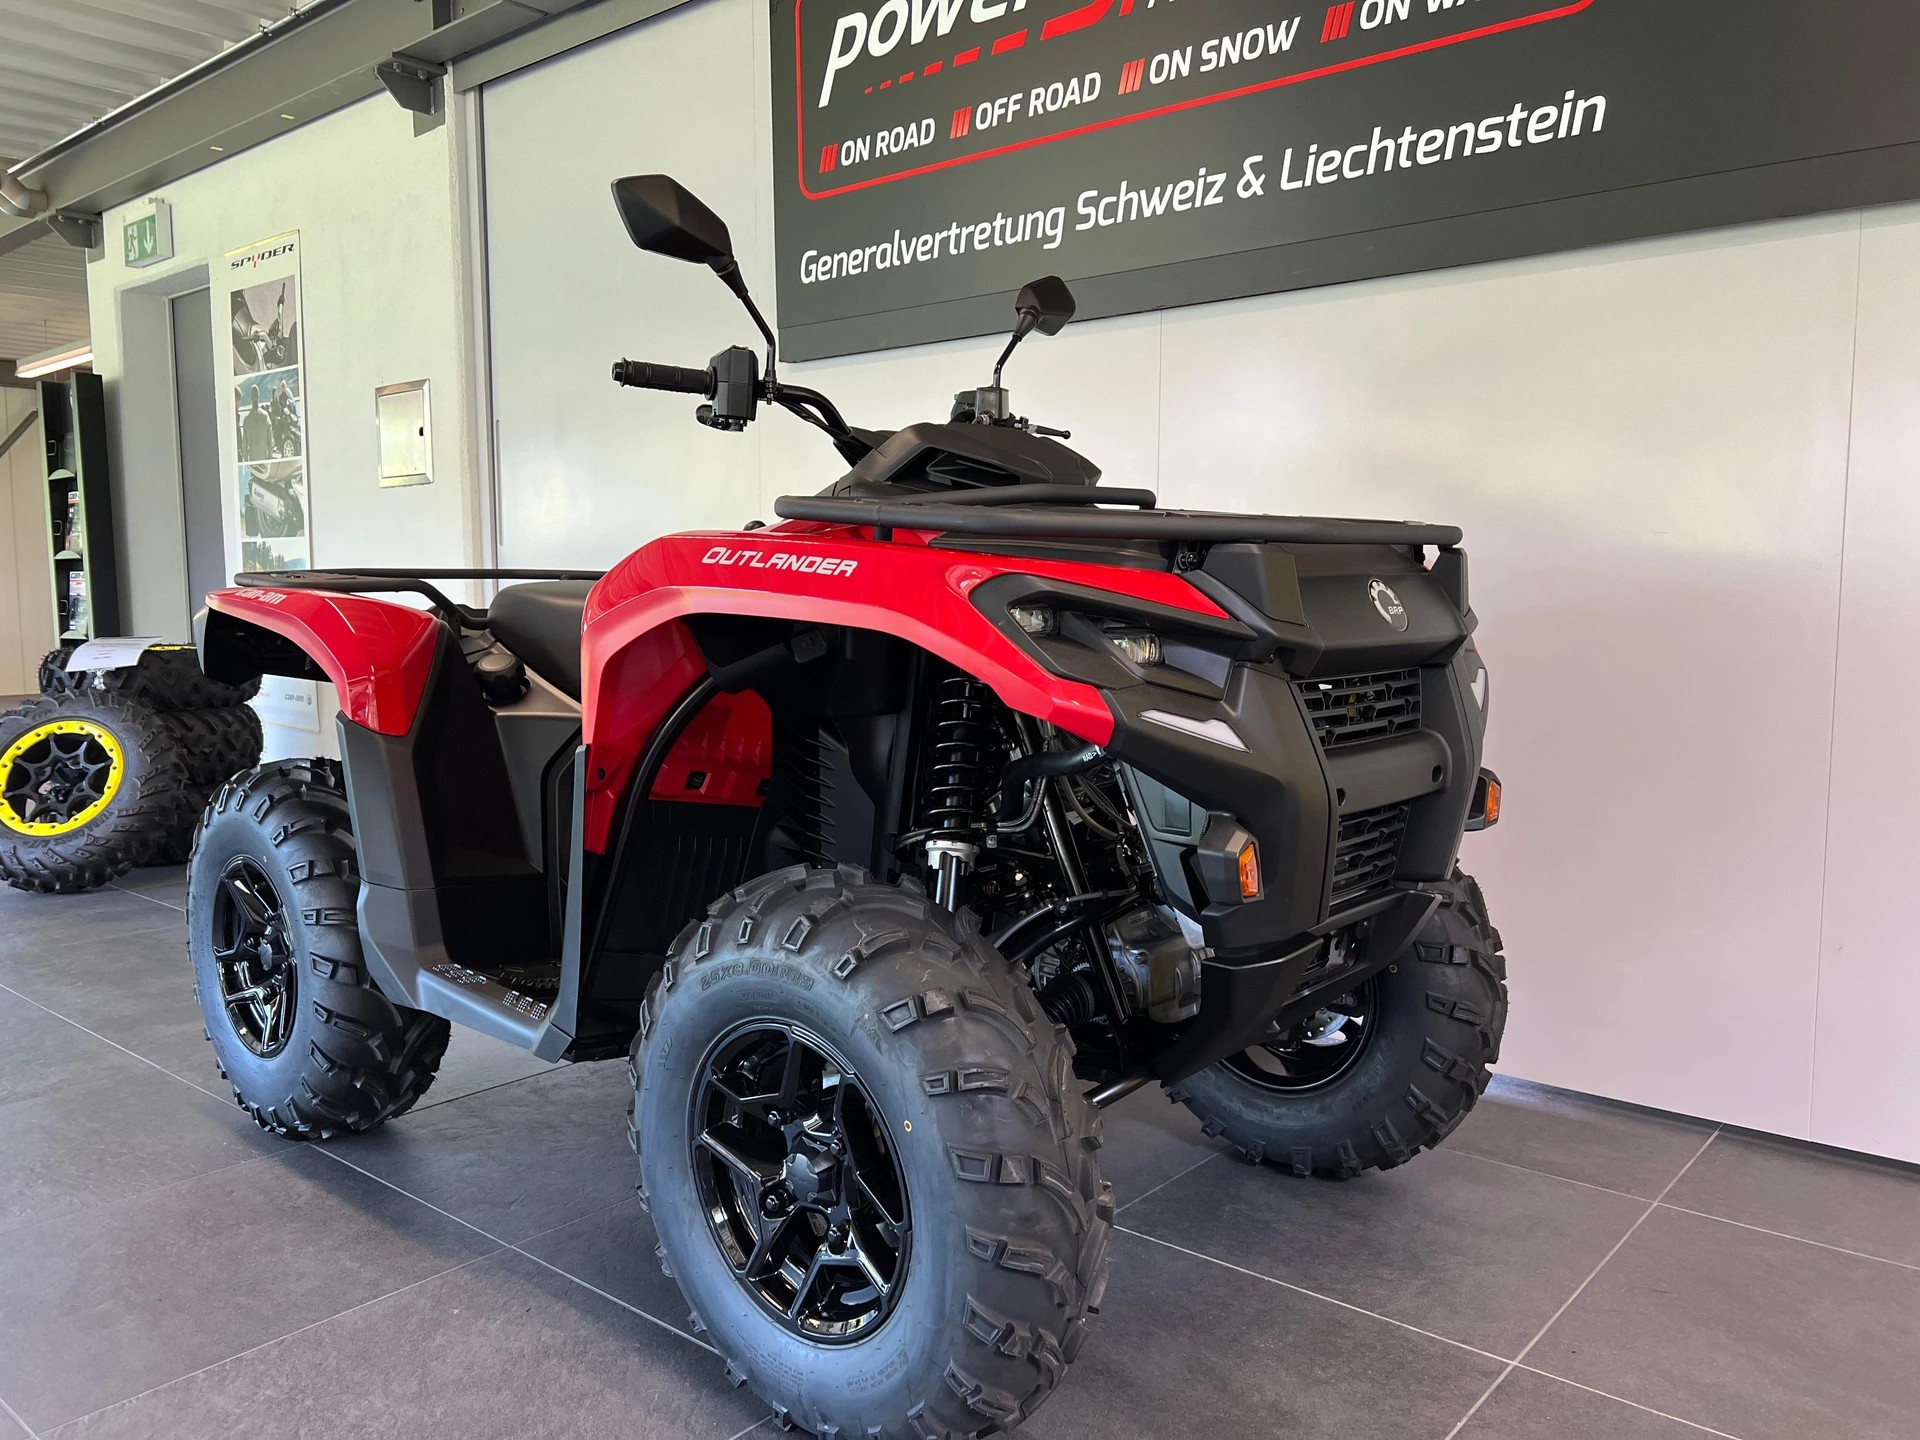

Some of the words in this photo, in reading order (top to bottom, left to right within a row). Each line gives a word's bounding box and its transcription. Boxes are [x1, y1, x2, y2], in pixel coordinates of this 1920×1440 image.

[1359, 0, 1411, 30] ON
[1149, 45, 1193, 85] ON
[1199, 16, 1302, 73] SNOW
[975, 93, 1024, 131] OFF
[1027, 72, 1102, 117] ROAD
[840, 134, 871, 167] ON
[875, 118, 936, 159] ROAD
[800, 206, 1066, 284] Generalvertretung
[1075, 167, 1228, 231] Schweiz
[1236, 154, 1266, 199] &
[1280, 89, 1608, 191] Liechtenstein
[230, 243, 295, 270] SPYDER
[701, 546, 858, 577] OUTLANDER
[1387, 605, 1404, 615] BRP
